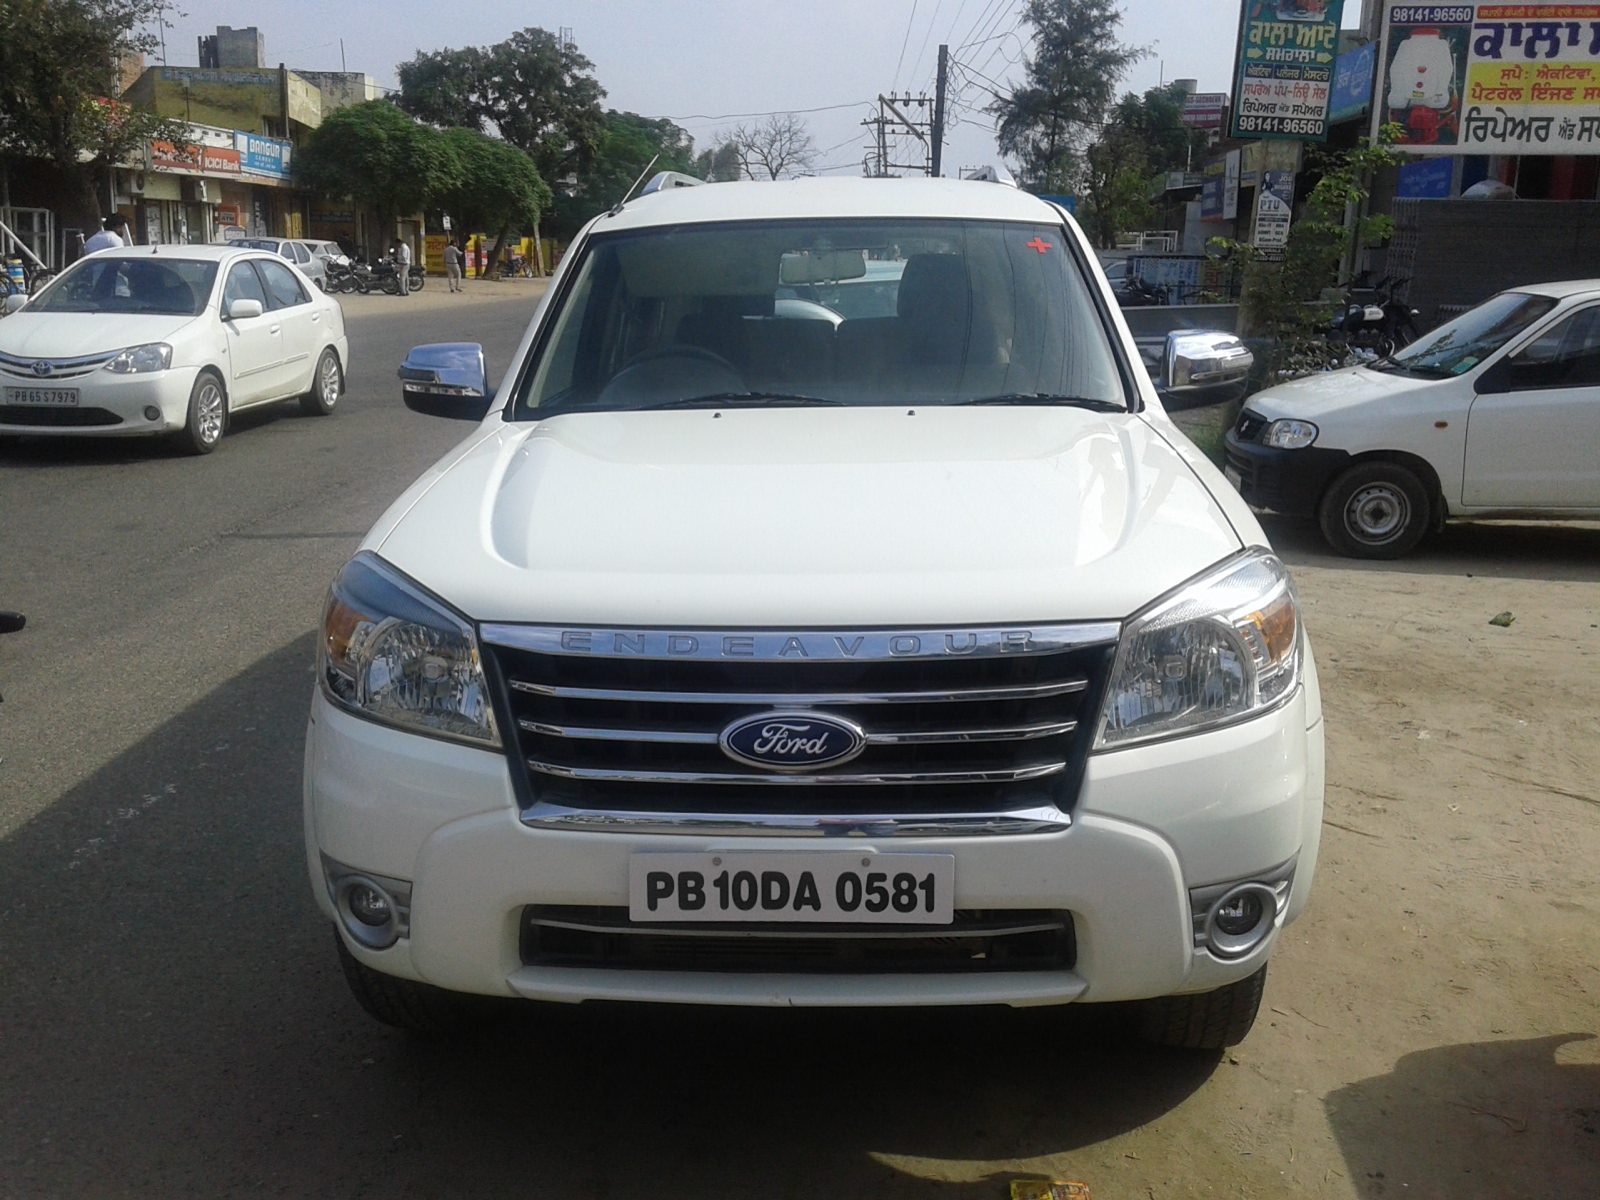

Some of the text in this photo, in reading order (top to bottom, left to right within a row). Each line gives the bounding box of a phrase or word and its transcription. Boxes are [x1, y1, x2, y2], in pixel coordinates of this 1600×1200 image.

[1393, 8, 1472, 21] 98141-96560
[1249, 21, 1294, 46] ਕਾਲਾ
[1473, 22, 1582, 59] ਕਾਲਾ
[1265, 47, 1316, 63] ਸਮਰਾਲਾ
[1312, 83, 1327, 100] ਸੇਲ
[1471, 82, 1524, 101] ਪੈਟਰੋਲ
[1243, 98, 1277, 114] ਰਿਪੇਅਰ
[1291, 102, 1324, 117] ਸਪੇਅਰ
[1239, 117, 1324, 134] 98141-96560
[1464, 106, 1555, 142] ਰਿਪੇਅਰ
[204, 157, 240, 171] ICICI Bank
[1260, 199, 1280, 210] PTU
[559, 630, 1035, 658] ENDEAVOUR
[753, 723, 830, 754] Ford
[835, 871, 936, 913] 0581
